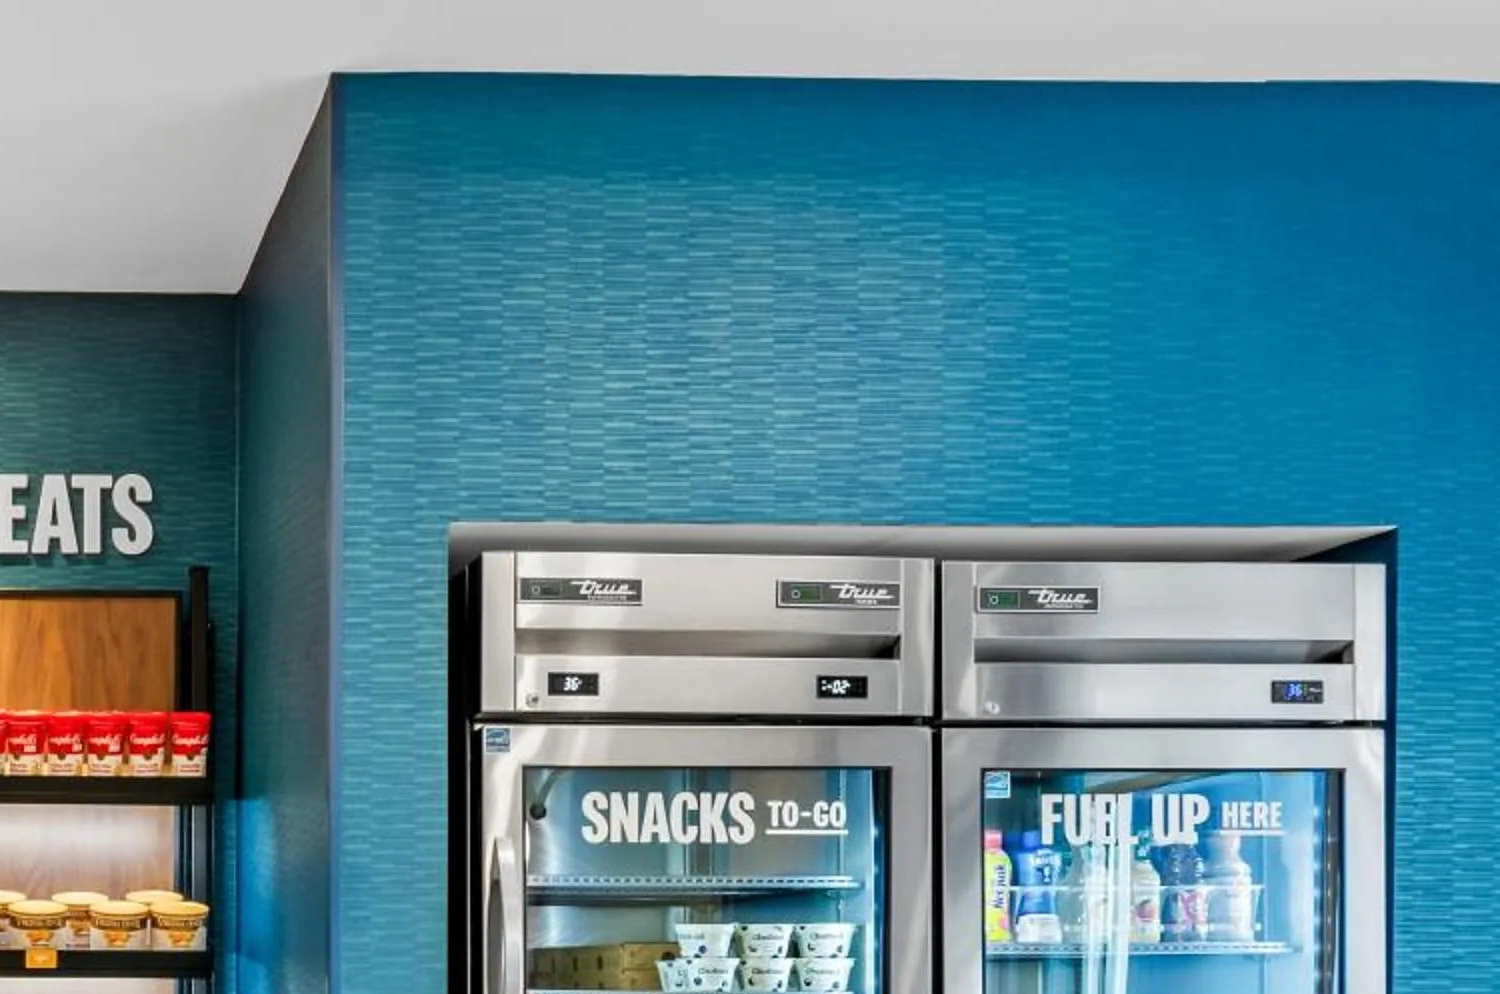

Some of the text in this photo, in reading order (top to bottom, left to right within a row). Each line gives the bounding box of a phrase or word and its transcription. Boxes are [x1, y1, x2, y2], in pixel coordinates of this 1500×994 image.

[581, 791, 847, 844] SNACKS TO-GO
[1041, 794, 1282, 846] FUEL UP HERE
